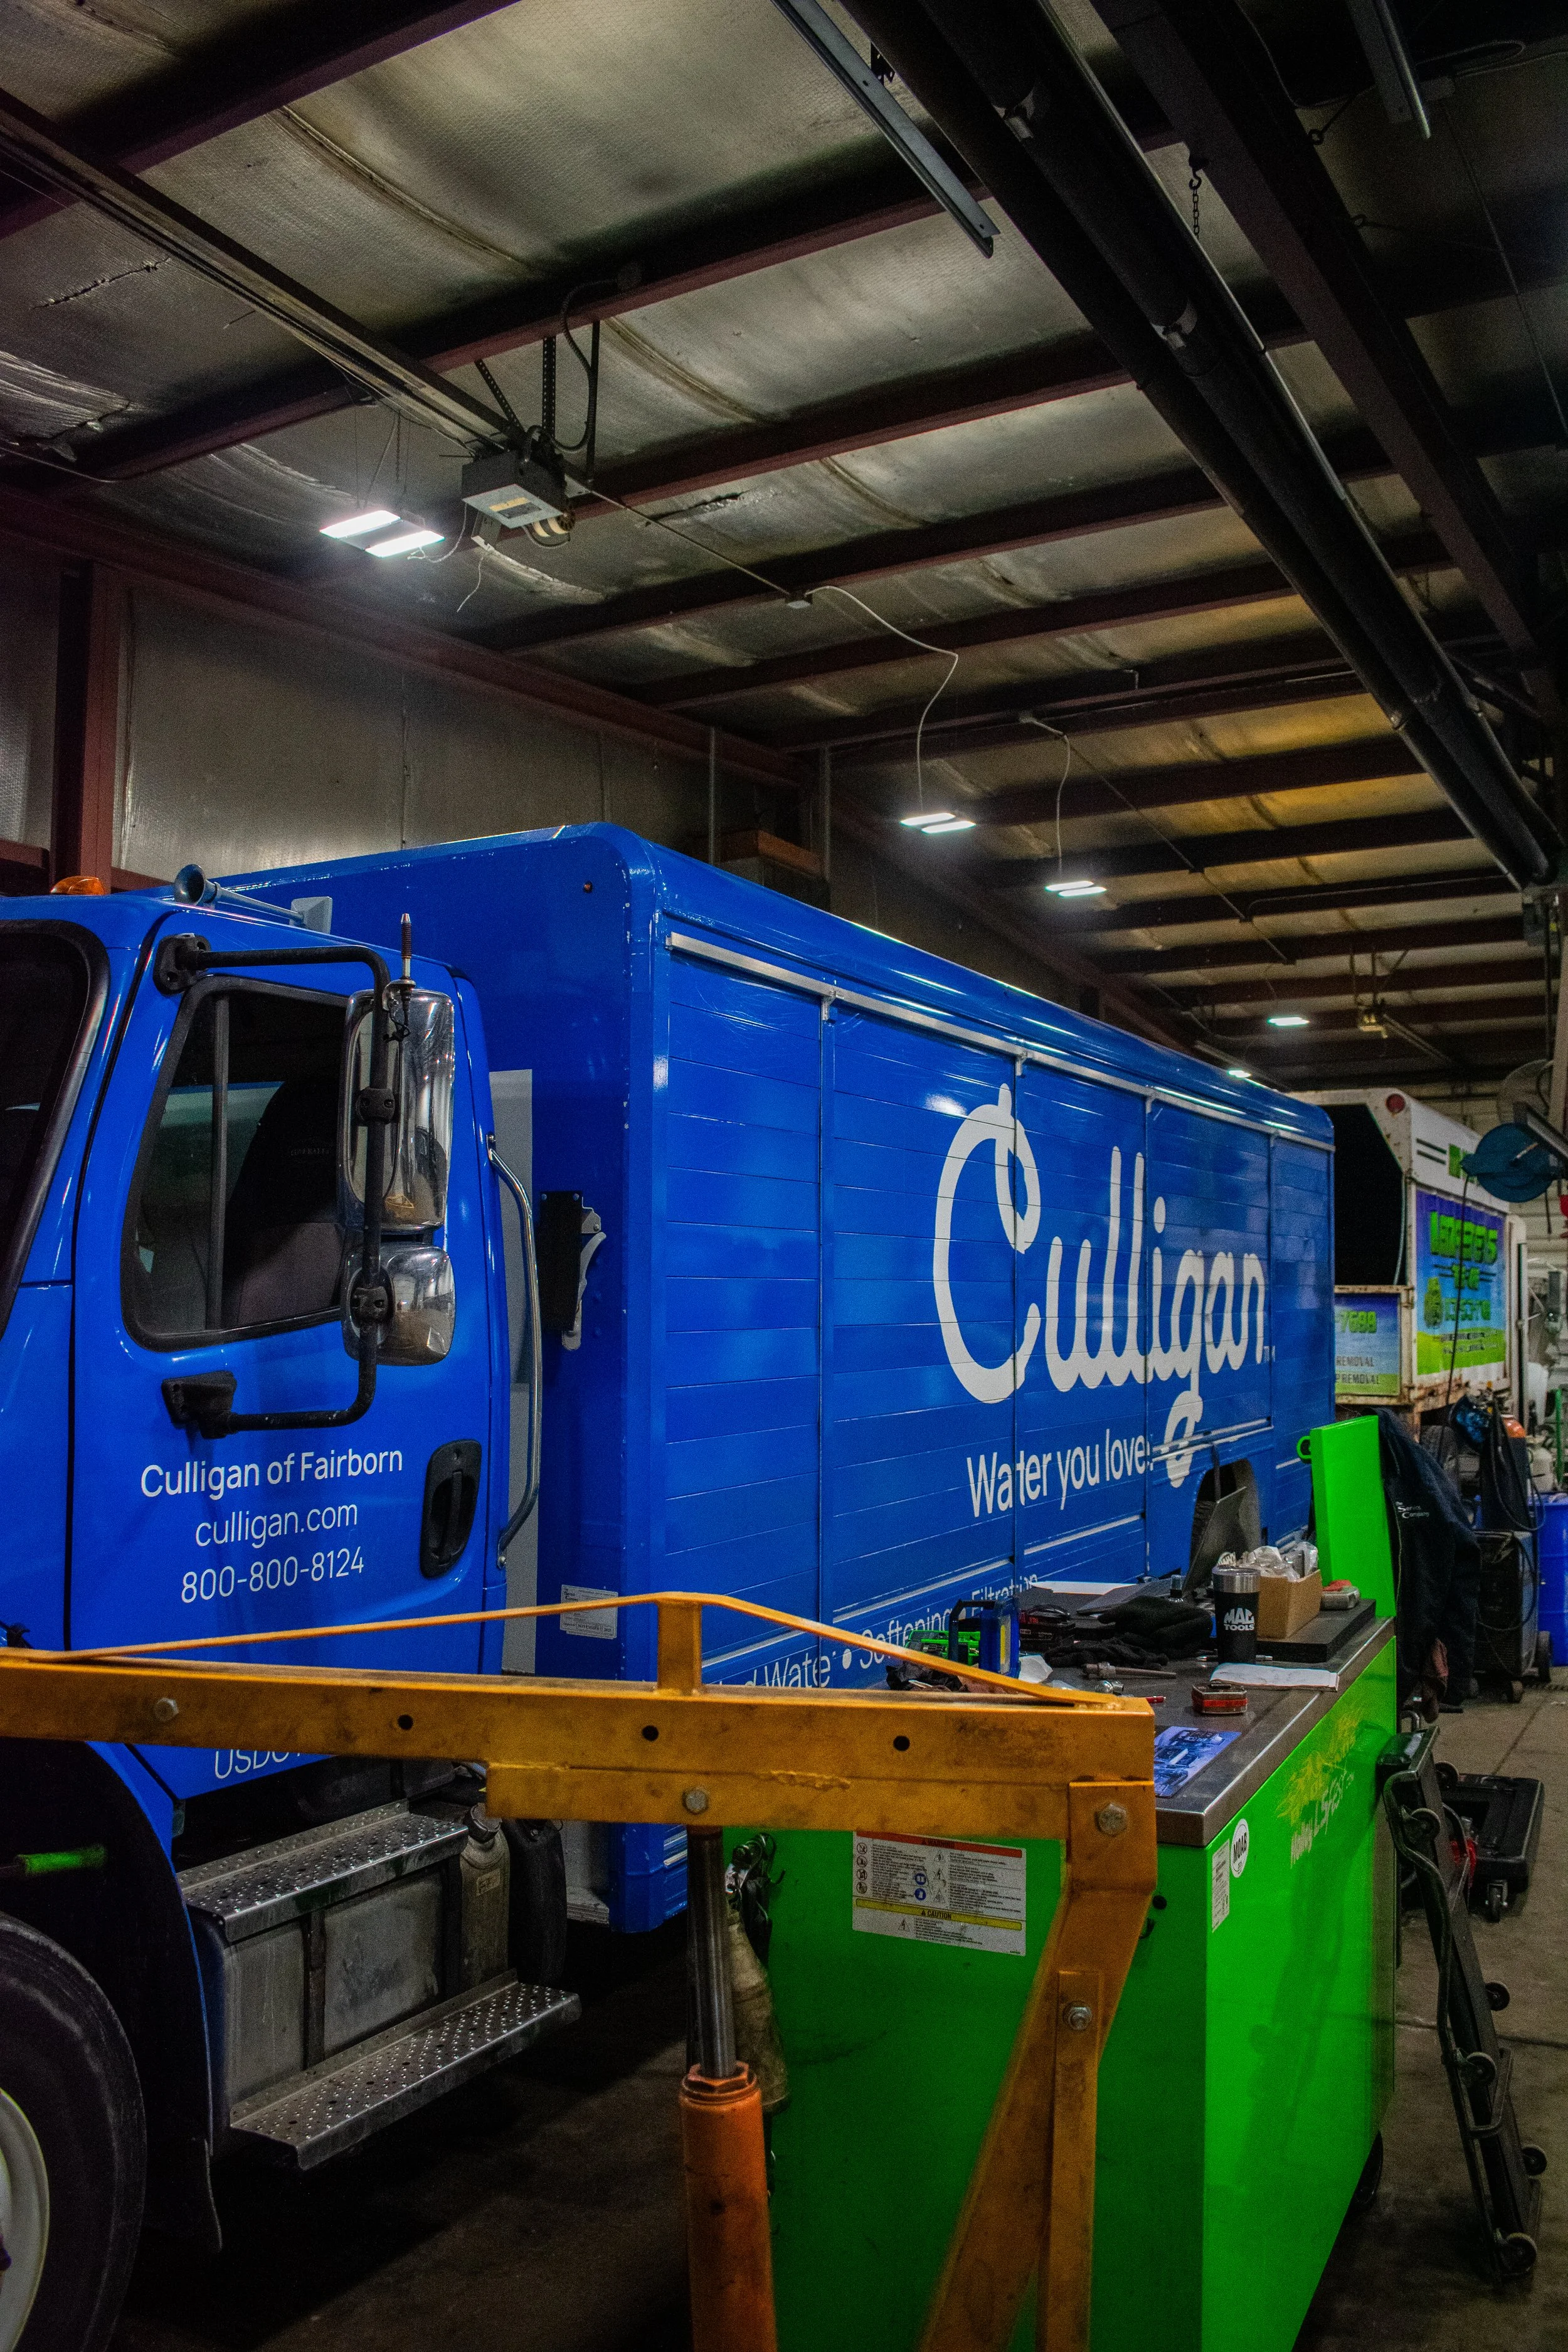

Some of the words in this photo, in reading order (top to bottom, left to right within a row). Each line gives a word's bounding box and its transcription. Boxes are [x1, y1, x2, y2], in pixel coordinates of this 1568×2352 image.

[933, 1083, 1264, 1488] Culligan
[140, 1460, 260, 1501] Culligan
[267, 1453, 295, 1485] of
[300, 1448, 403, 1481] Fairborn
[967, 1450, 1052, 1518] Water
[1057, 1444, 1100, 1511] you
[195, 1504, 358, 1549] culligan.com
[181, 1546, 364, 1604] 800-800-8124
[1223, 1608, 1254, 1624] MAC
[1224, 1623, 1255, 1631] TOOLS
[765, 1651, 837, 1688] Wate
[215, 1749, 300, 1779] USD
[1233, 1831, 1248, 1864] MOAB
[927, 1909, 952, 1920] CAUTION
